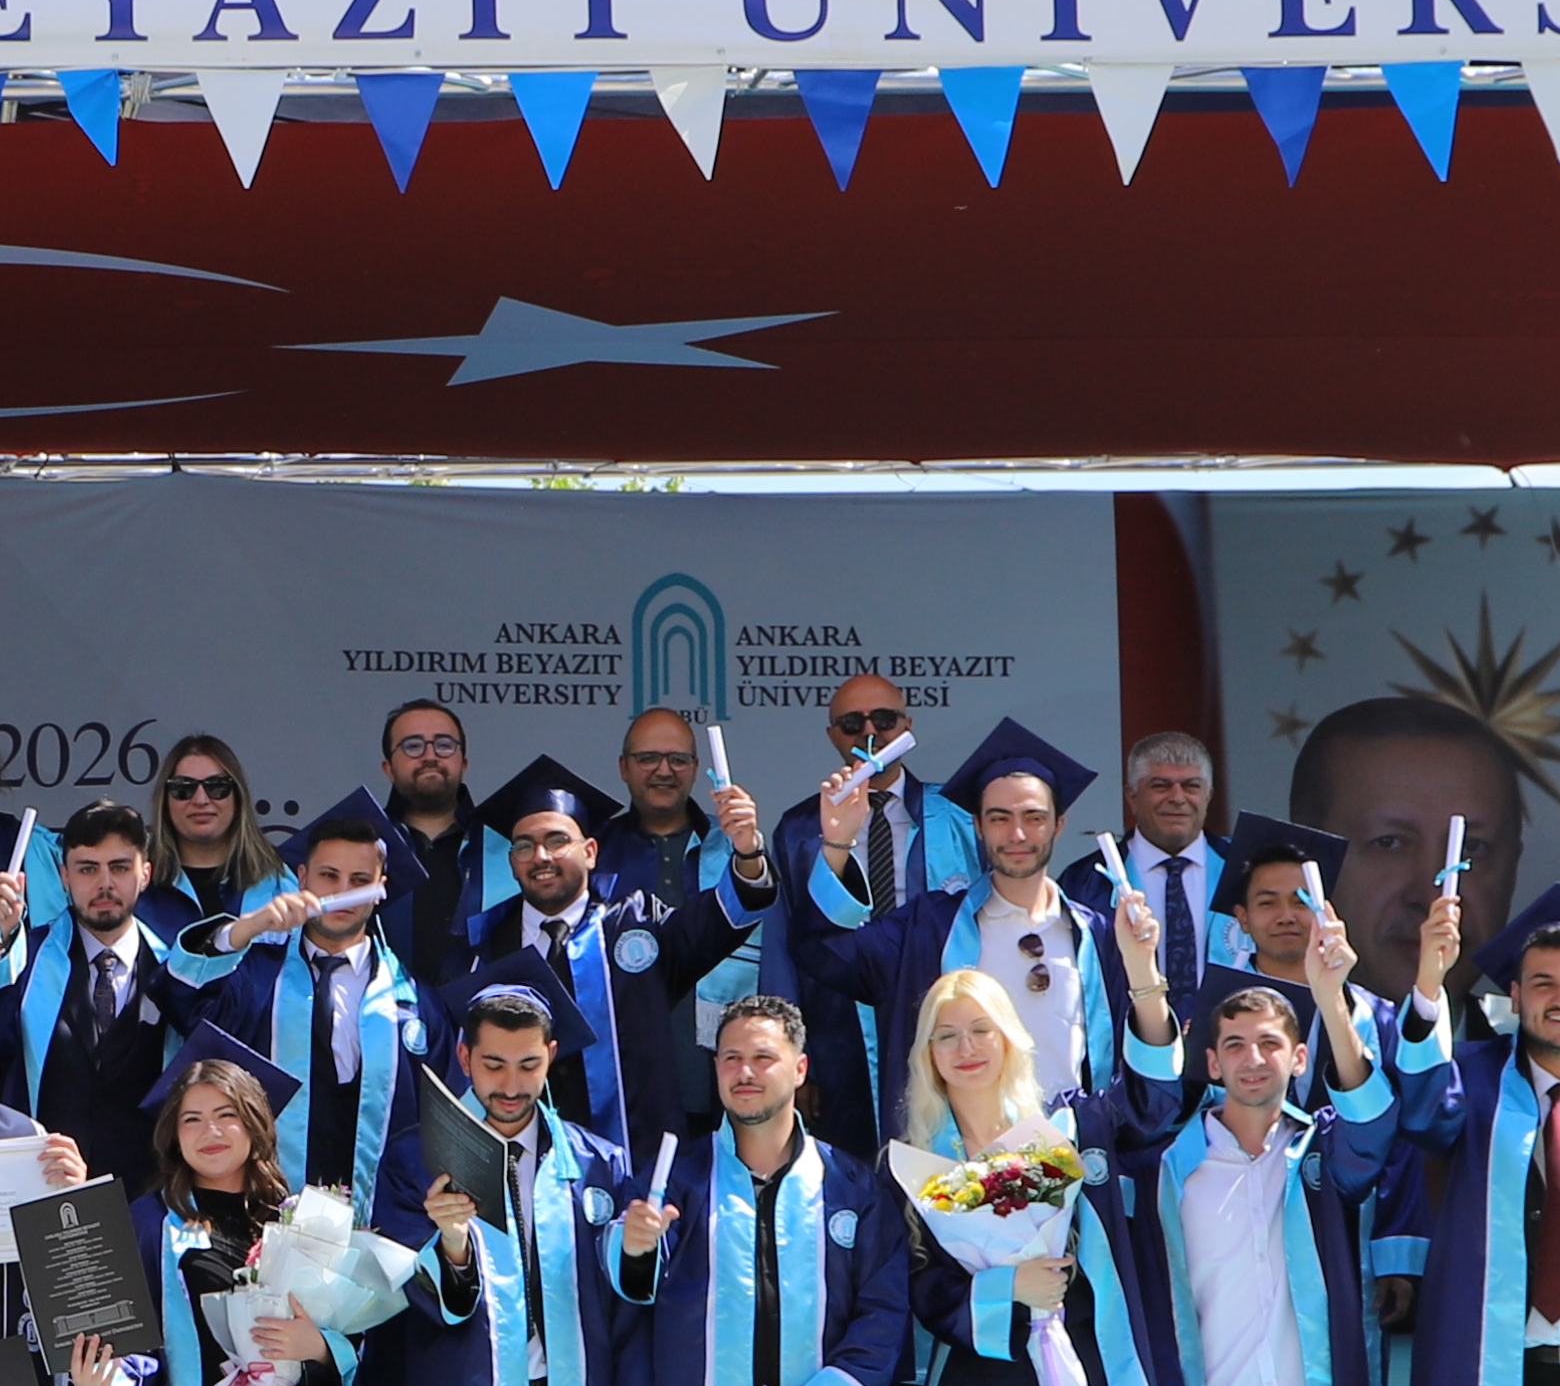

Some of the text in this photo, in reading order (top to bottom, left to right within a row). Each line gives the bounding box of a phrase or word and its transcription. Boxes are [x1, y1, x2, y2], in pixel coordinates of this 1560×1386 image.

[495, 623, 621, 644] ANKARA
[736, 626, 861, 646] ANKARA
[343, 650, 622, 674] YILDIRIM BEYAZIT
[737, 656, 1014, 678] YILDIRIM BEYAZIT
[435, 682, 621, 706] UNIVERSITY
